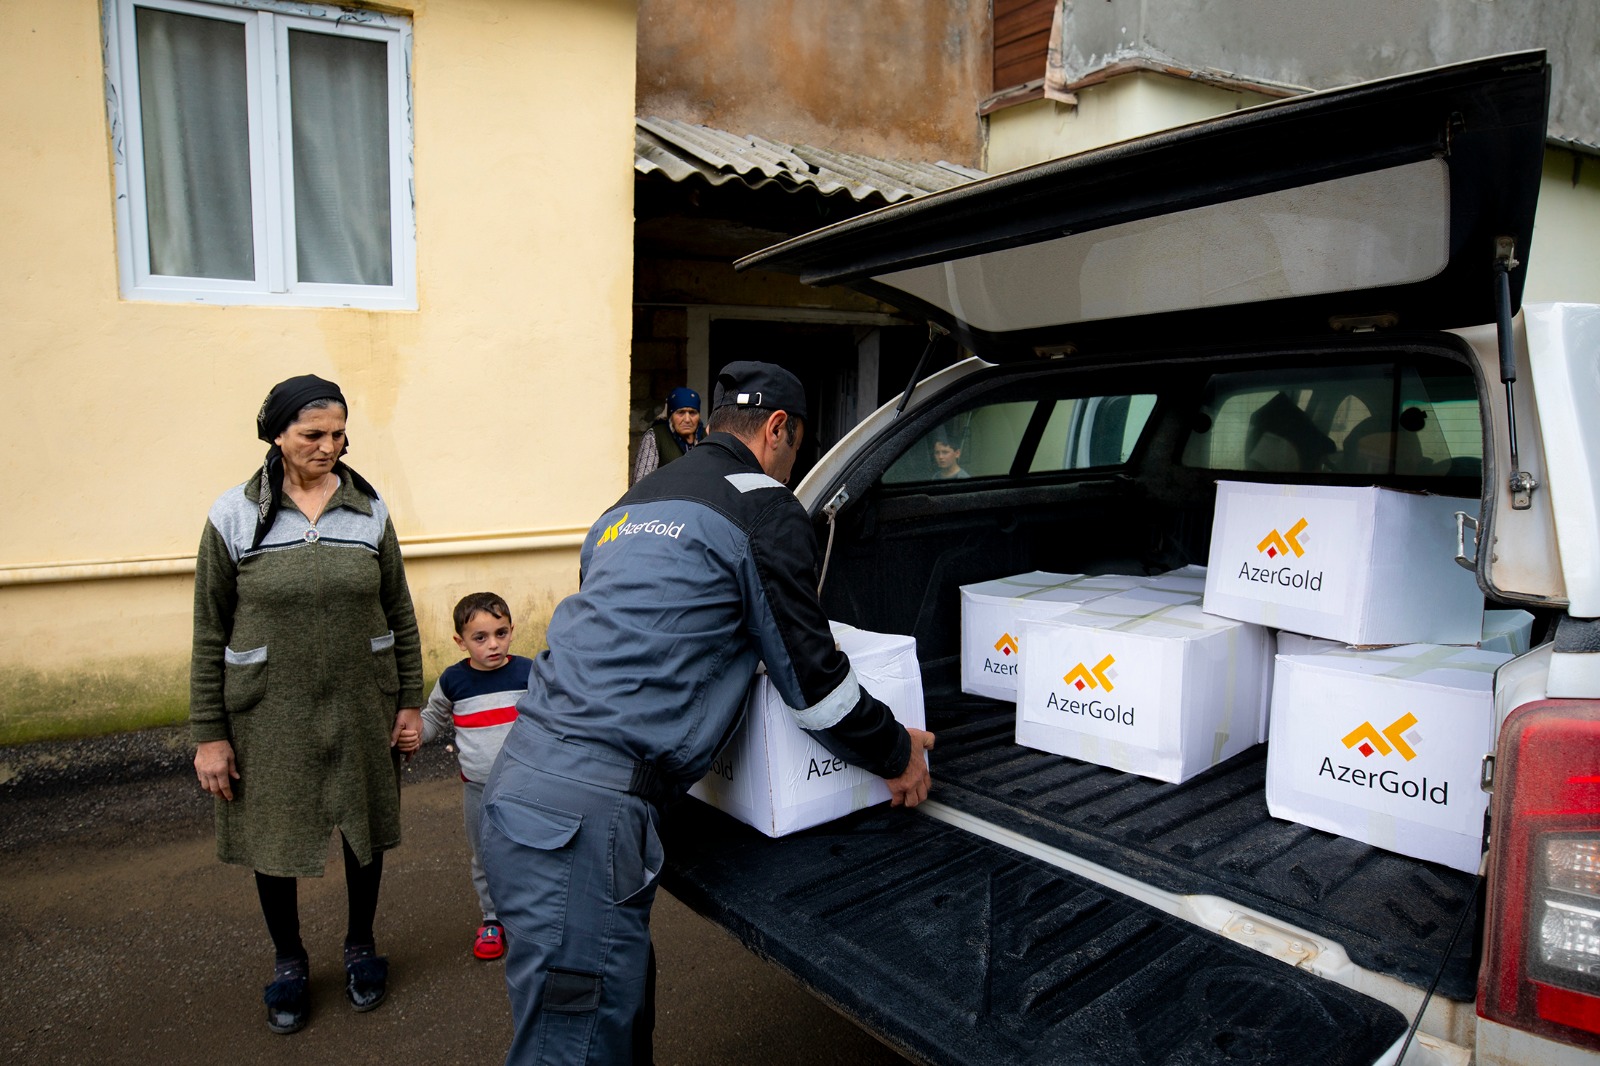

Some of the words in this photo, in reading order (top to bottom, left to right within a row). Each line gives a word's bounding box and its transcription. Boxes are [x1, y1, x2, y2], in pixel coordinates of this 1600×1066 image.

[619, 519, 686, 539] AzerGold
[1238, 561, 1323, 592] AzerGold
[1046, 692, 1135, 726] AzerGold
[710, 756, 734, 782] old
[1318, 756, 1449, 806] AzerGold
